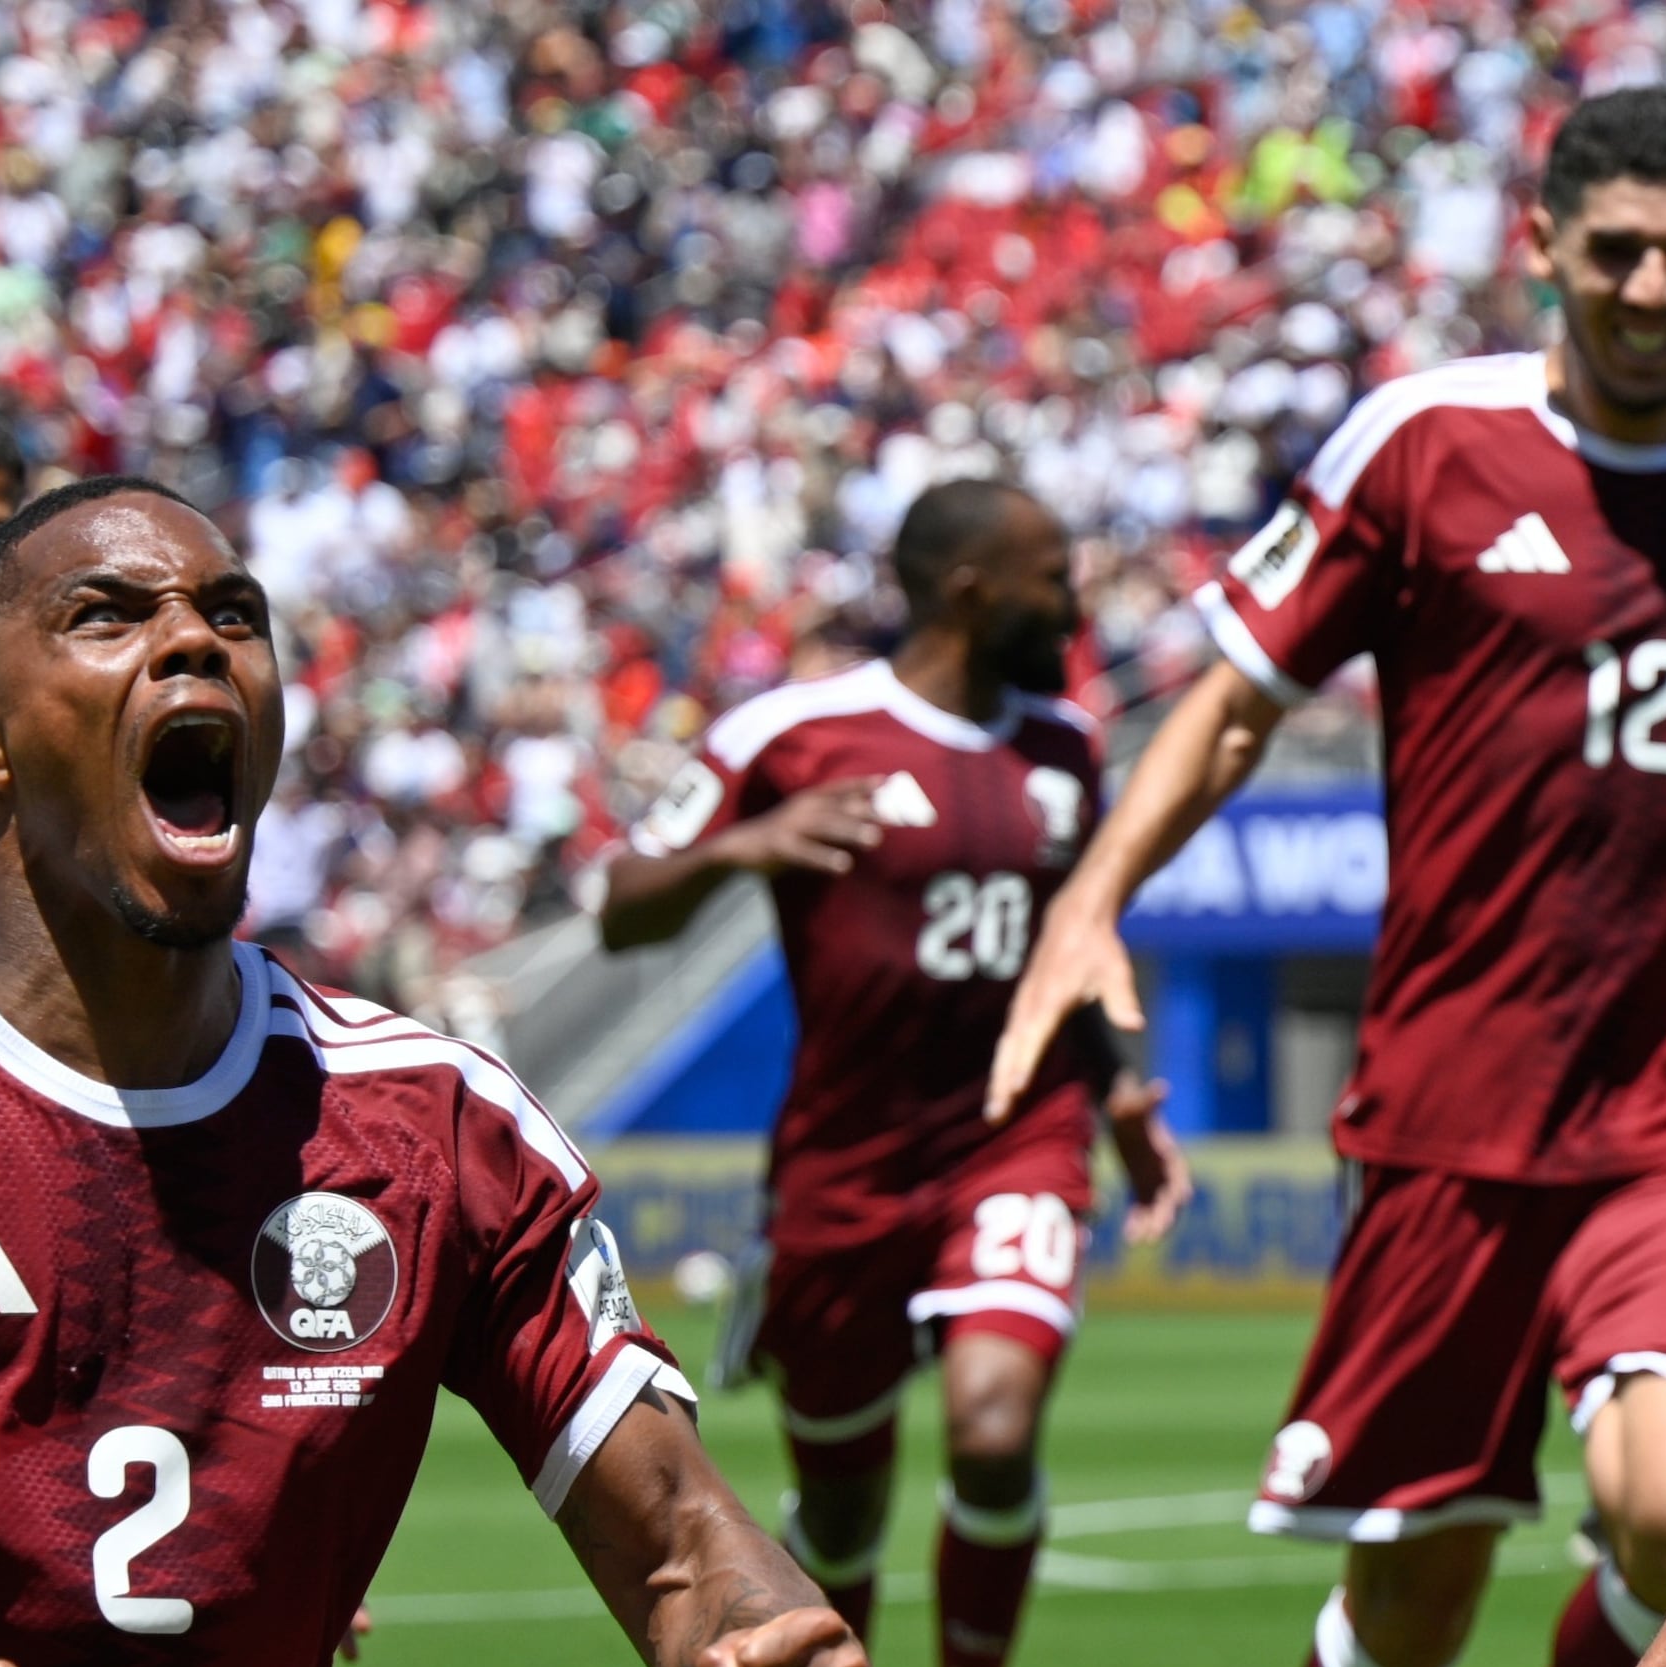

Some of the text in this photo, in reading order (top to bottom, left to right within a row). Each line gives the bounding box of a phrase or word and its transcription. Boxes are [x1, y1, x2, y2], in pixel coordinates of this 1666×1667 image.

[917, 871, 1031, 980] 20
[970, 1192, 1075, 1288] 20
[290, 1308, 355, 1339] QFA
[88, 1425, 194, 1634] 2
